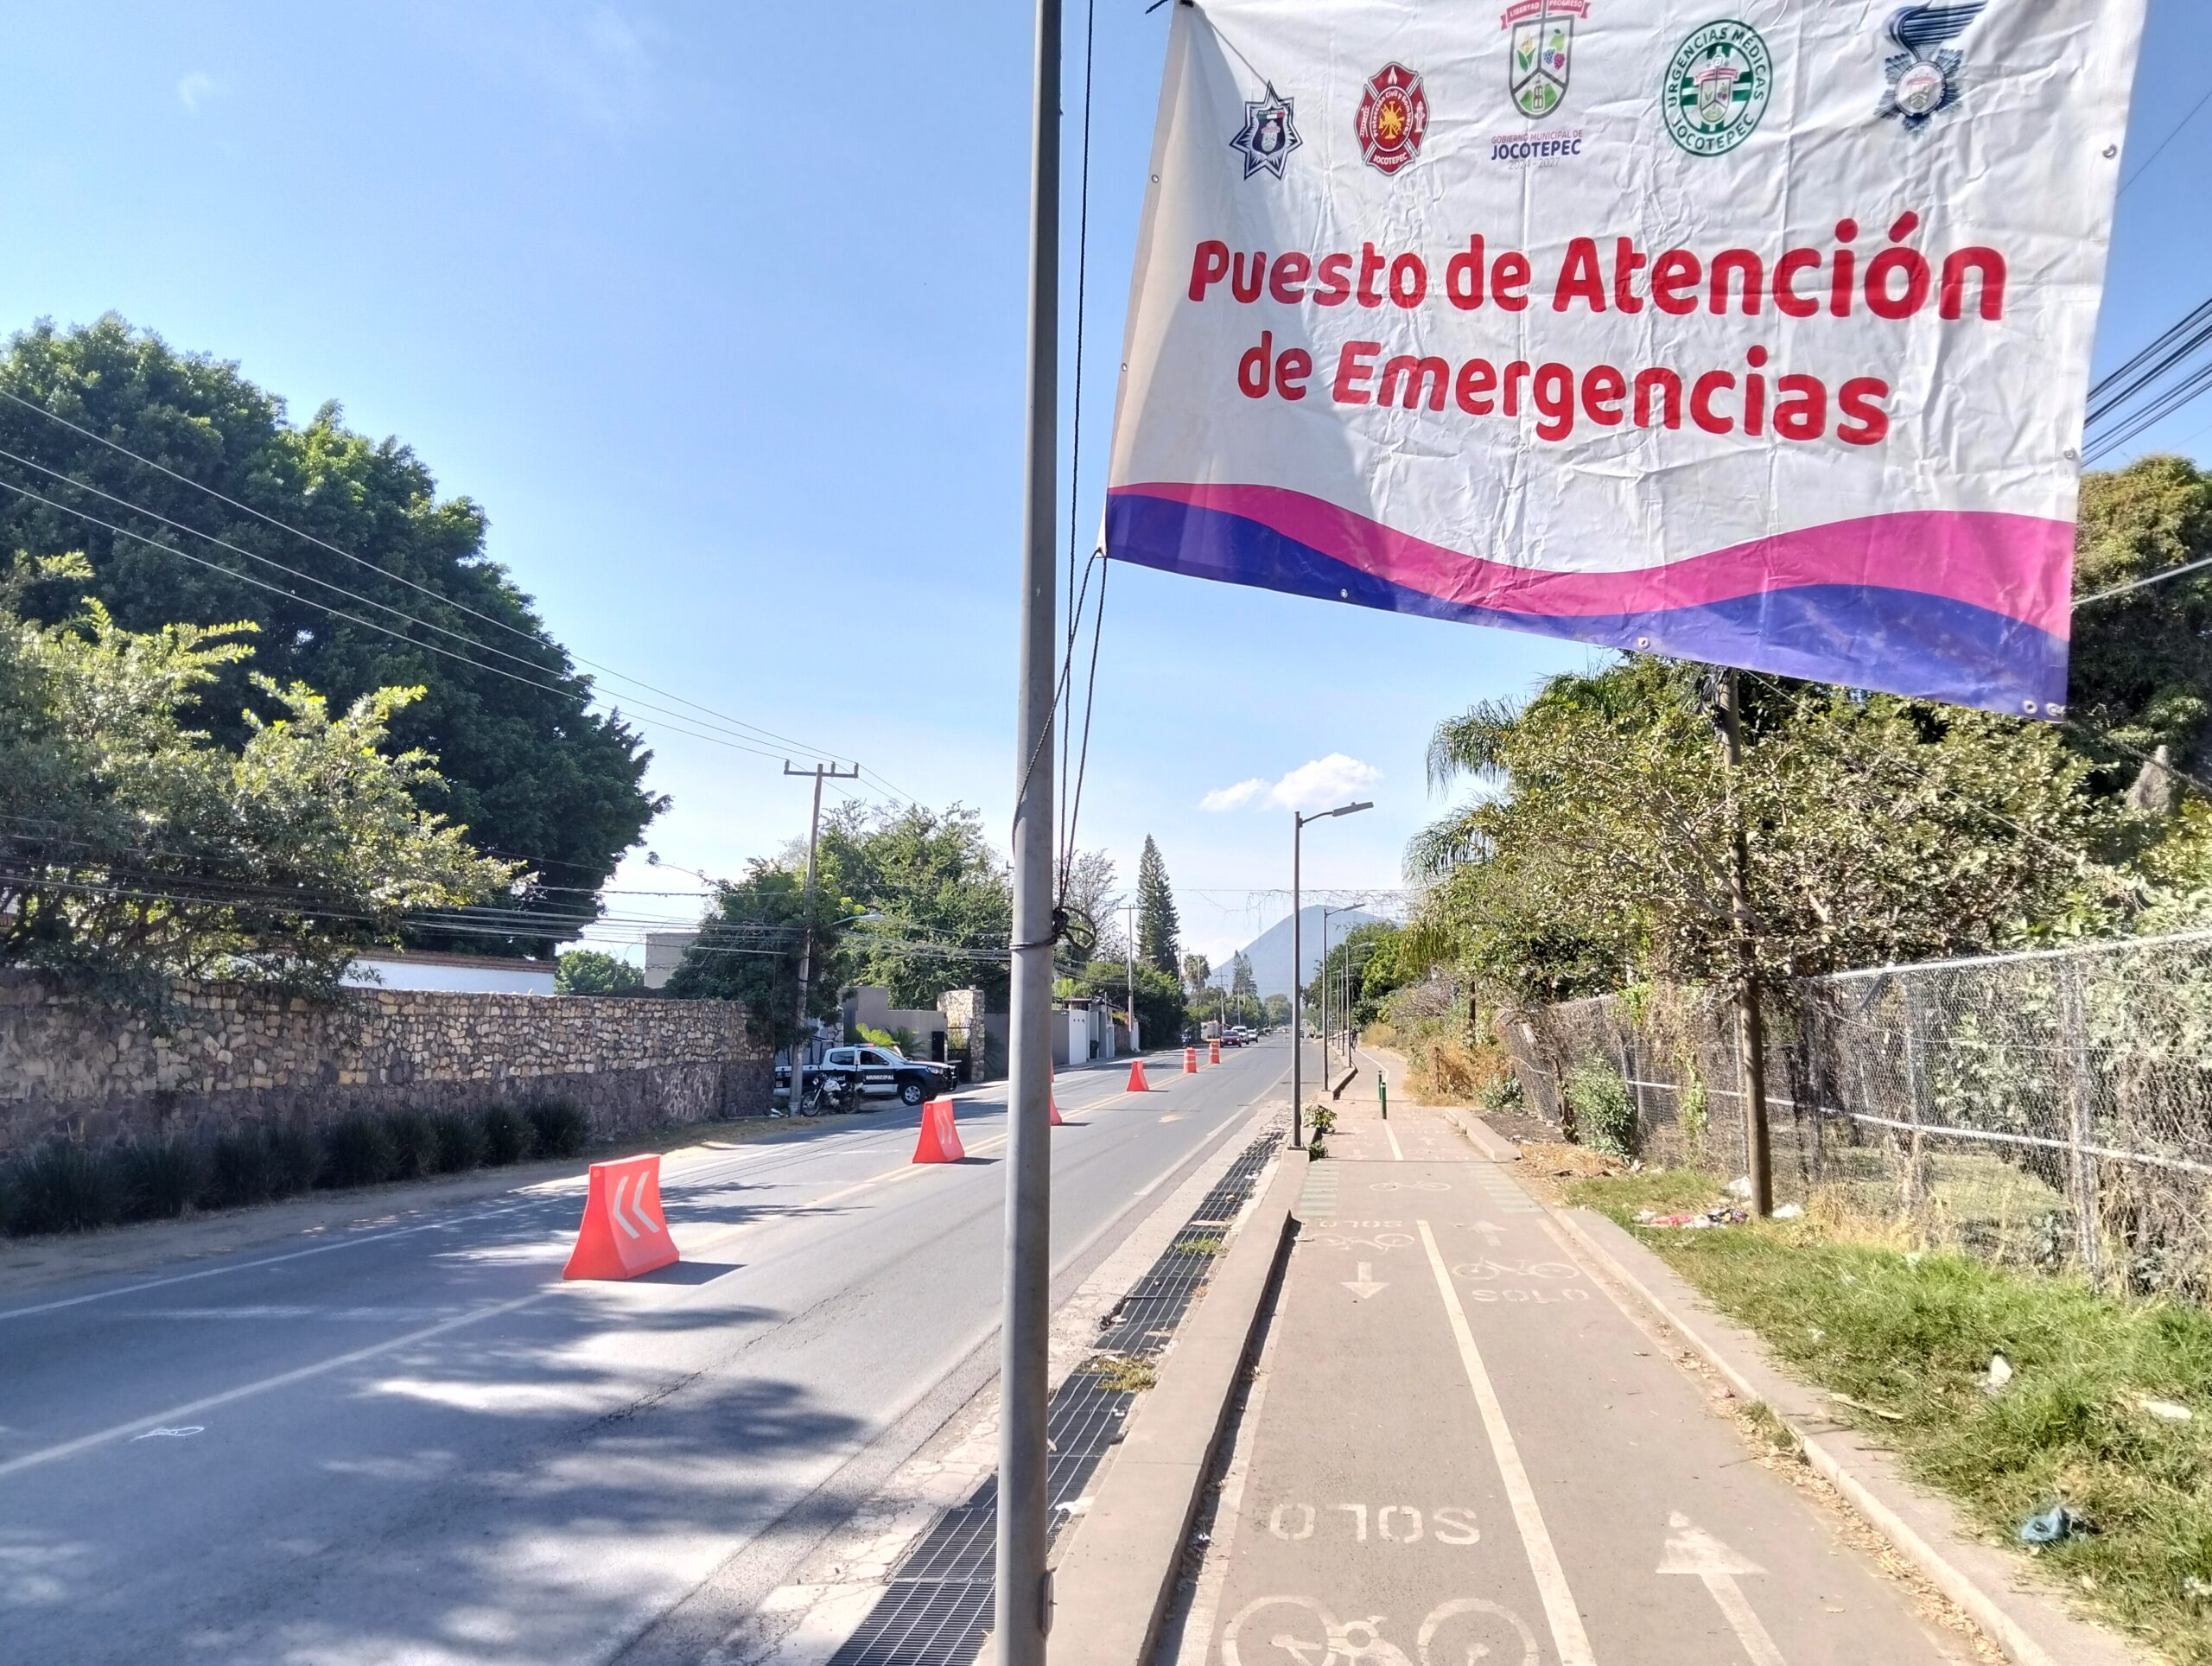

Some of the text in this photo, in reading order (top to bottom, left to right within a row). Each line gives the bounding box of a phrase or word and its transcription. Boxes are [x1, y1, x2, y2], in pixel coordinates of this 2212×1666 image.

[1510, 2, 1539, 17] LIBERTAD
[1669, 27, 1727, 107] URGENCIAS
[1385, 89, 1398, 98] Civil
[1491, 130, 1583, 144] GOBIERNO MUNICIPAL DE
[1672, 112, 1754, 151] JOCOTEPEC
[1373, 151, 1408, 165] JOCOTEPEC
[1491, 139, 1582, 161] JOCOTEPEC
[1538, 157, 1560, 169] 2027
[1190, 211, 2008, 321] Puesto de Atención
[1239, 332, 1890, 445] de Emergencias
[1471, 1288, 1591, 1304] SOLO
[1268, 1502, 1481, 1546] SOLO
